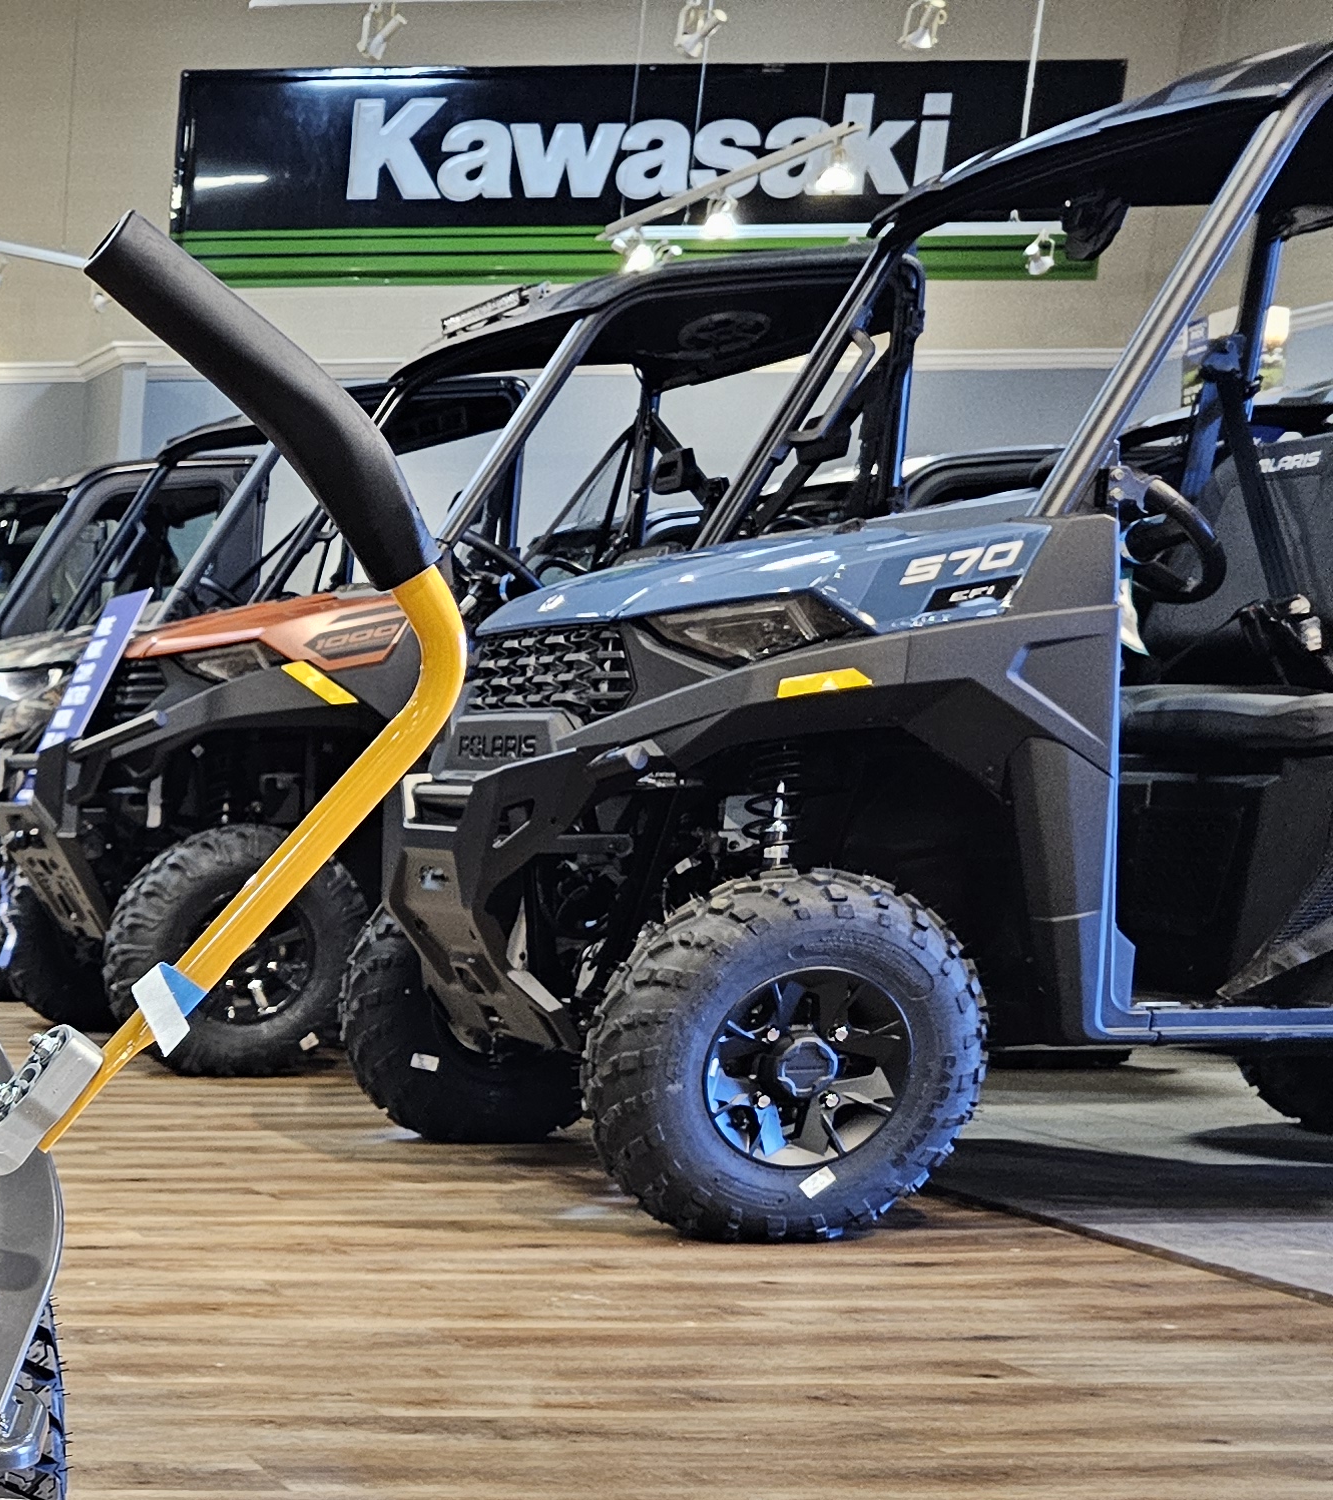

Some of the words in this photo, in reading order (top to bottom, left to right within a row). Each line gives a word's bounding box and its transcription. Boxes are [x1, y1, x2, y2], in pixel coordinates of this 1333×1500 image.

[346, 93, 953, 202] Kawasaki
[899, 540, 1024, 586] 570
[949, 585, 996, 602] EFI
[315, 623, 400, 650] 1000
[458, 734, 537, 759] POLARIS
